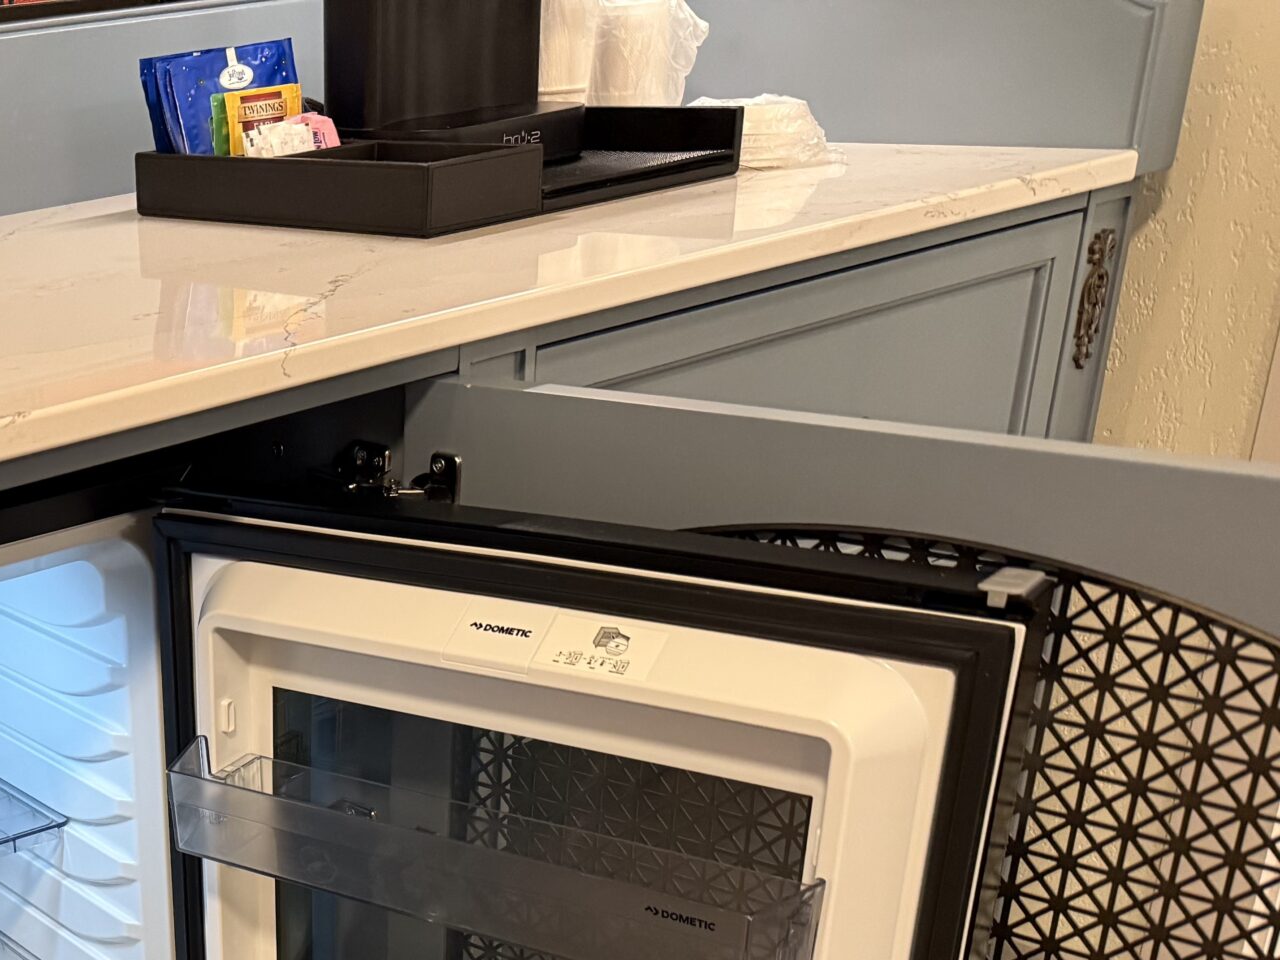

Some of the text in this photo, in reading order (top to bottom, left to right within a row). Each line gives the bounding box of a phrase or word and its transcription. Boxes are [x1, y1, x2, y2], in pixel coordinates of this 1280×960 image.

[243, 101, 284, 116] TWININGS
[483, 623, 532, 638] DOMETIC
[661, 909, 716, 931] DOMETIC
